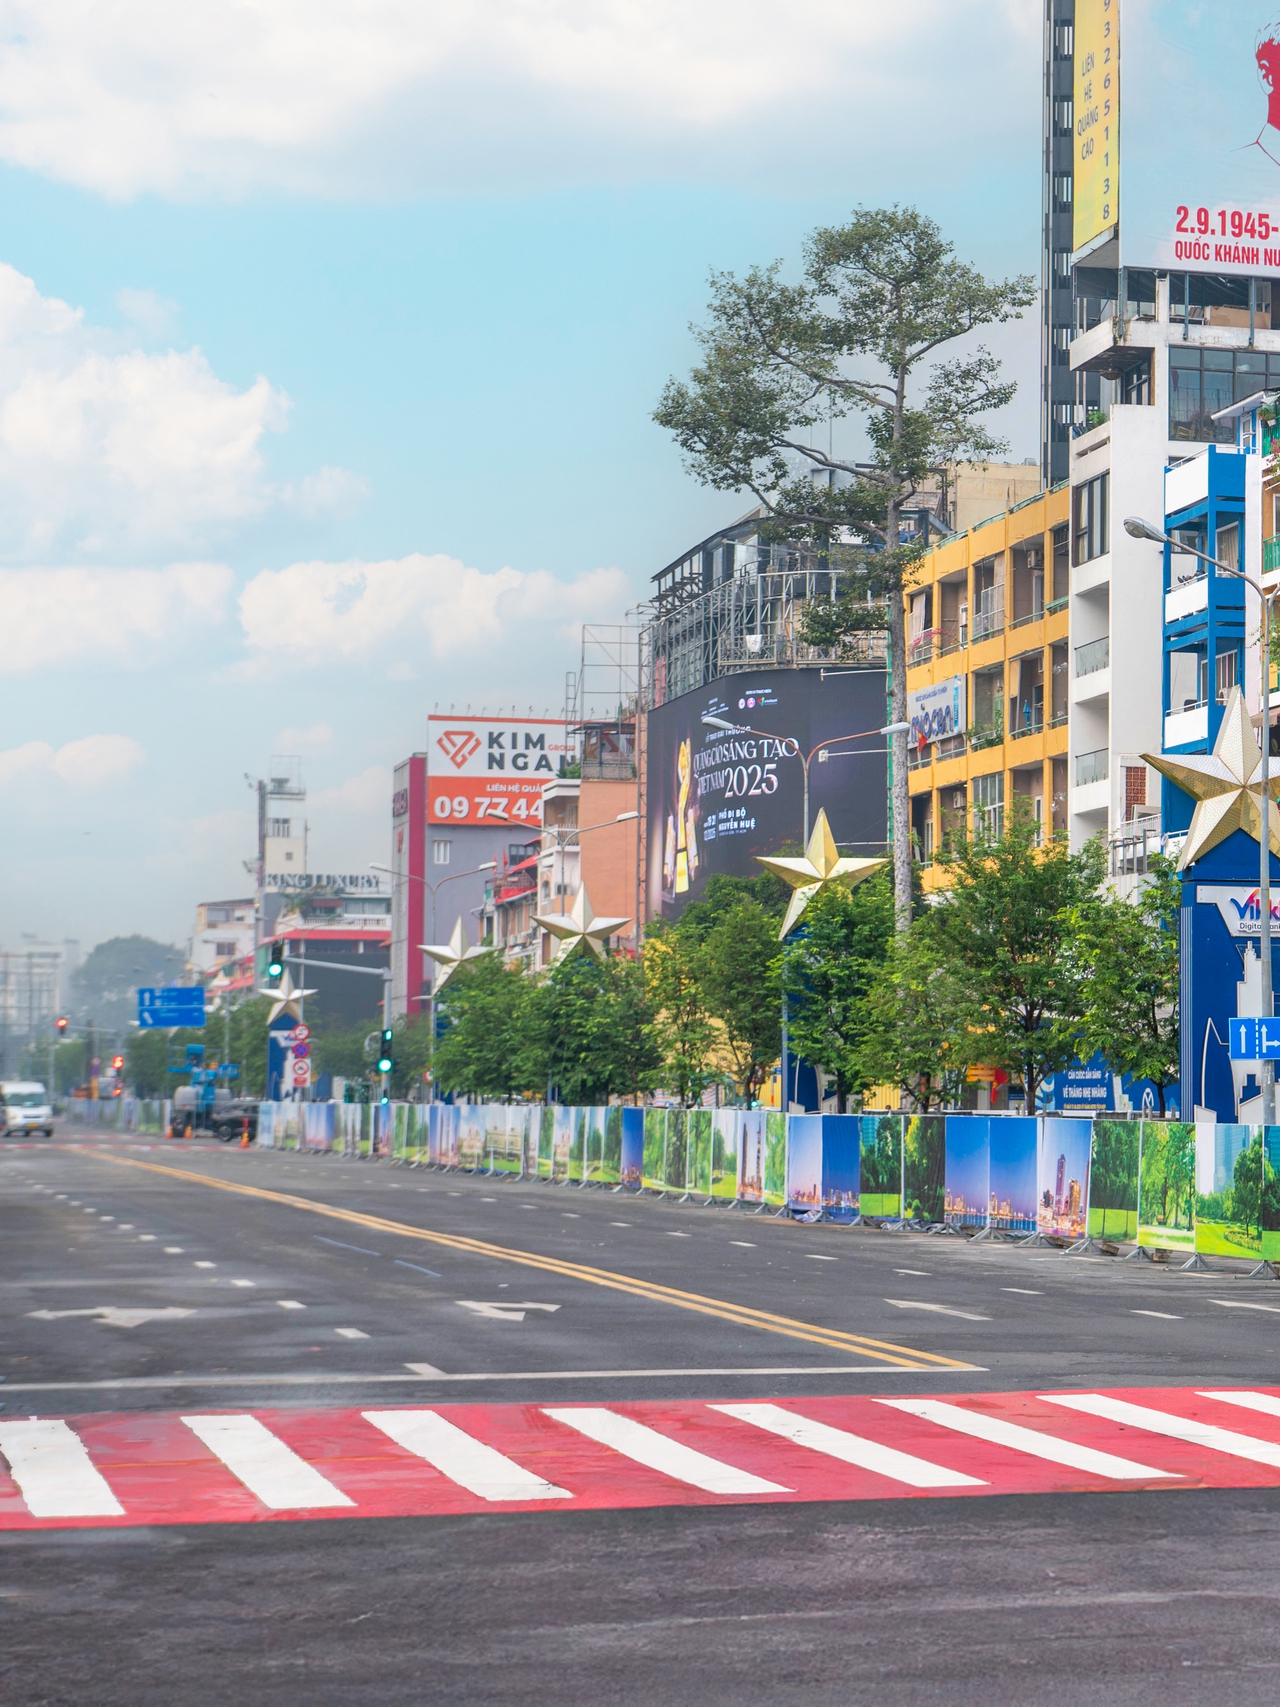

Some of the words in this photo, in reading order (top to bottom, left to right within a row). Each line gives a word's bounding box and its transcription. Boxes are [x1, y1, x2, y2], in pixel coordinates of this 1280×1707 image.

[1077, 105, 1099, 137] QUẢNG
[1081, 137, 1095, 160] CÁO
[1175, 236, 1210, 261] QUỐC
[1214, 242, 1260, 265] KHÁNH
[488, 731, 546, 750] KIM
[723, 739, 757, 762] SÁNG
[759, 737, 799, 761] TẠO
[487, 752, 576, 772] NGAN
[486, 783, 507, 792] LIÊN
[508, 783, 521, 794] HỆ
[724, 763, 779, 798] 2025
[735, 806, 747, 819] BỘ
[739, 817, 756, 830] HUỆ
[265, 873, 307, 887] KING
[1239, 922, 1261, 931] Digita
[1062, 1084, 1069, 1098] VÉ
[1069, 1084, 1082, 1098] THÁNG
